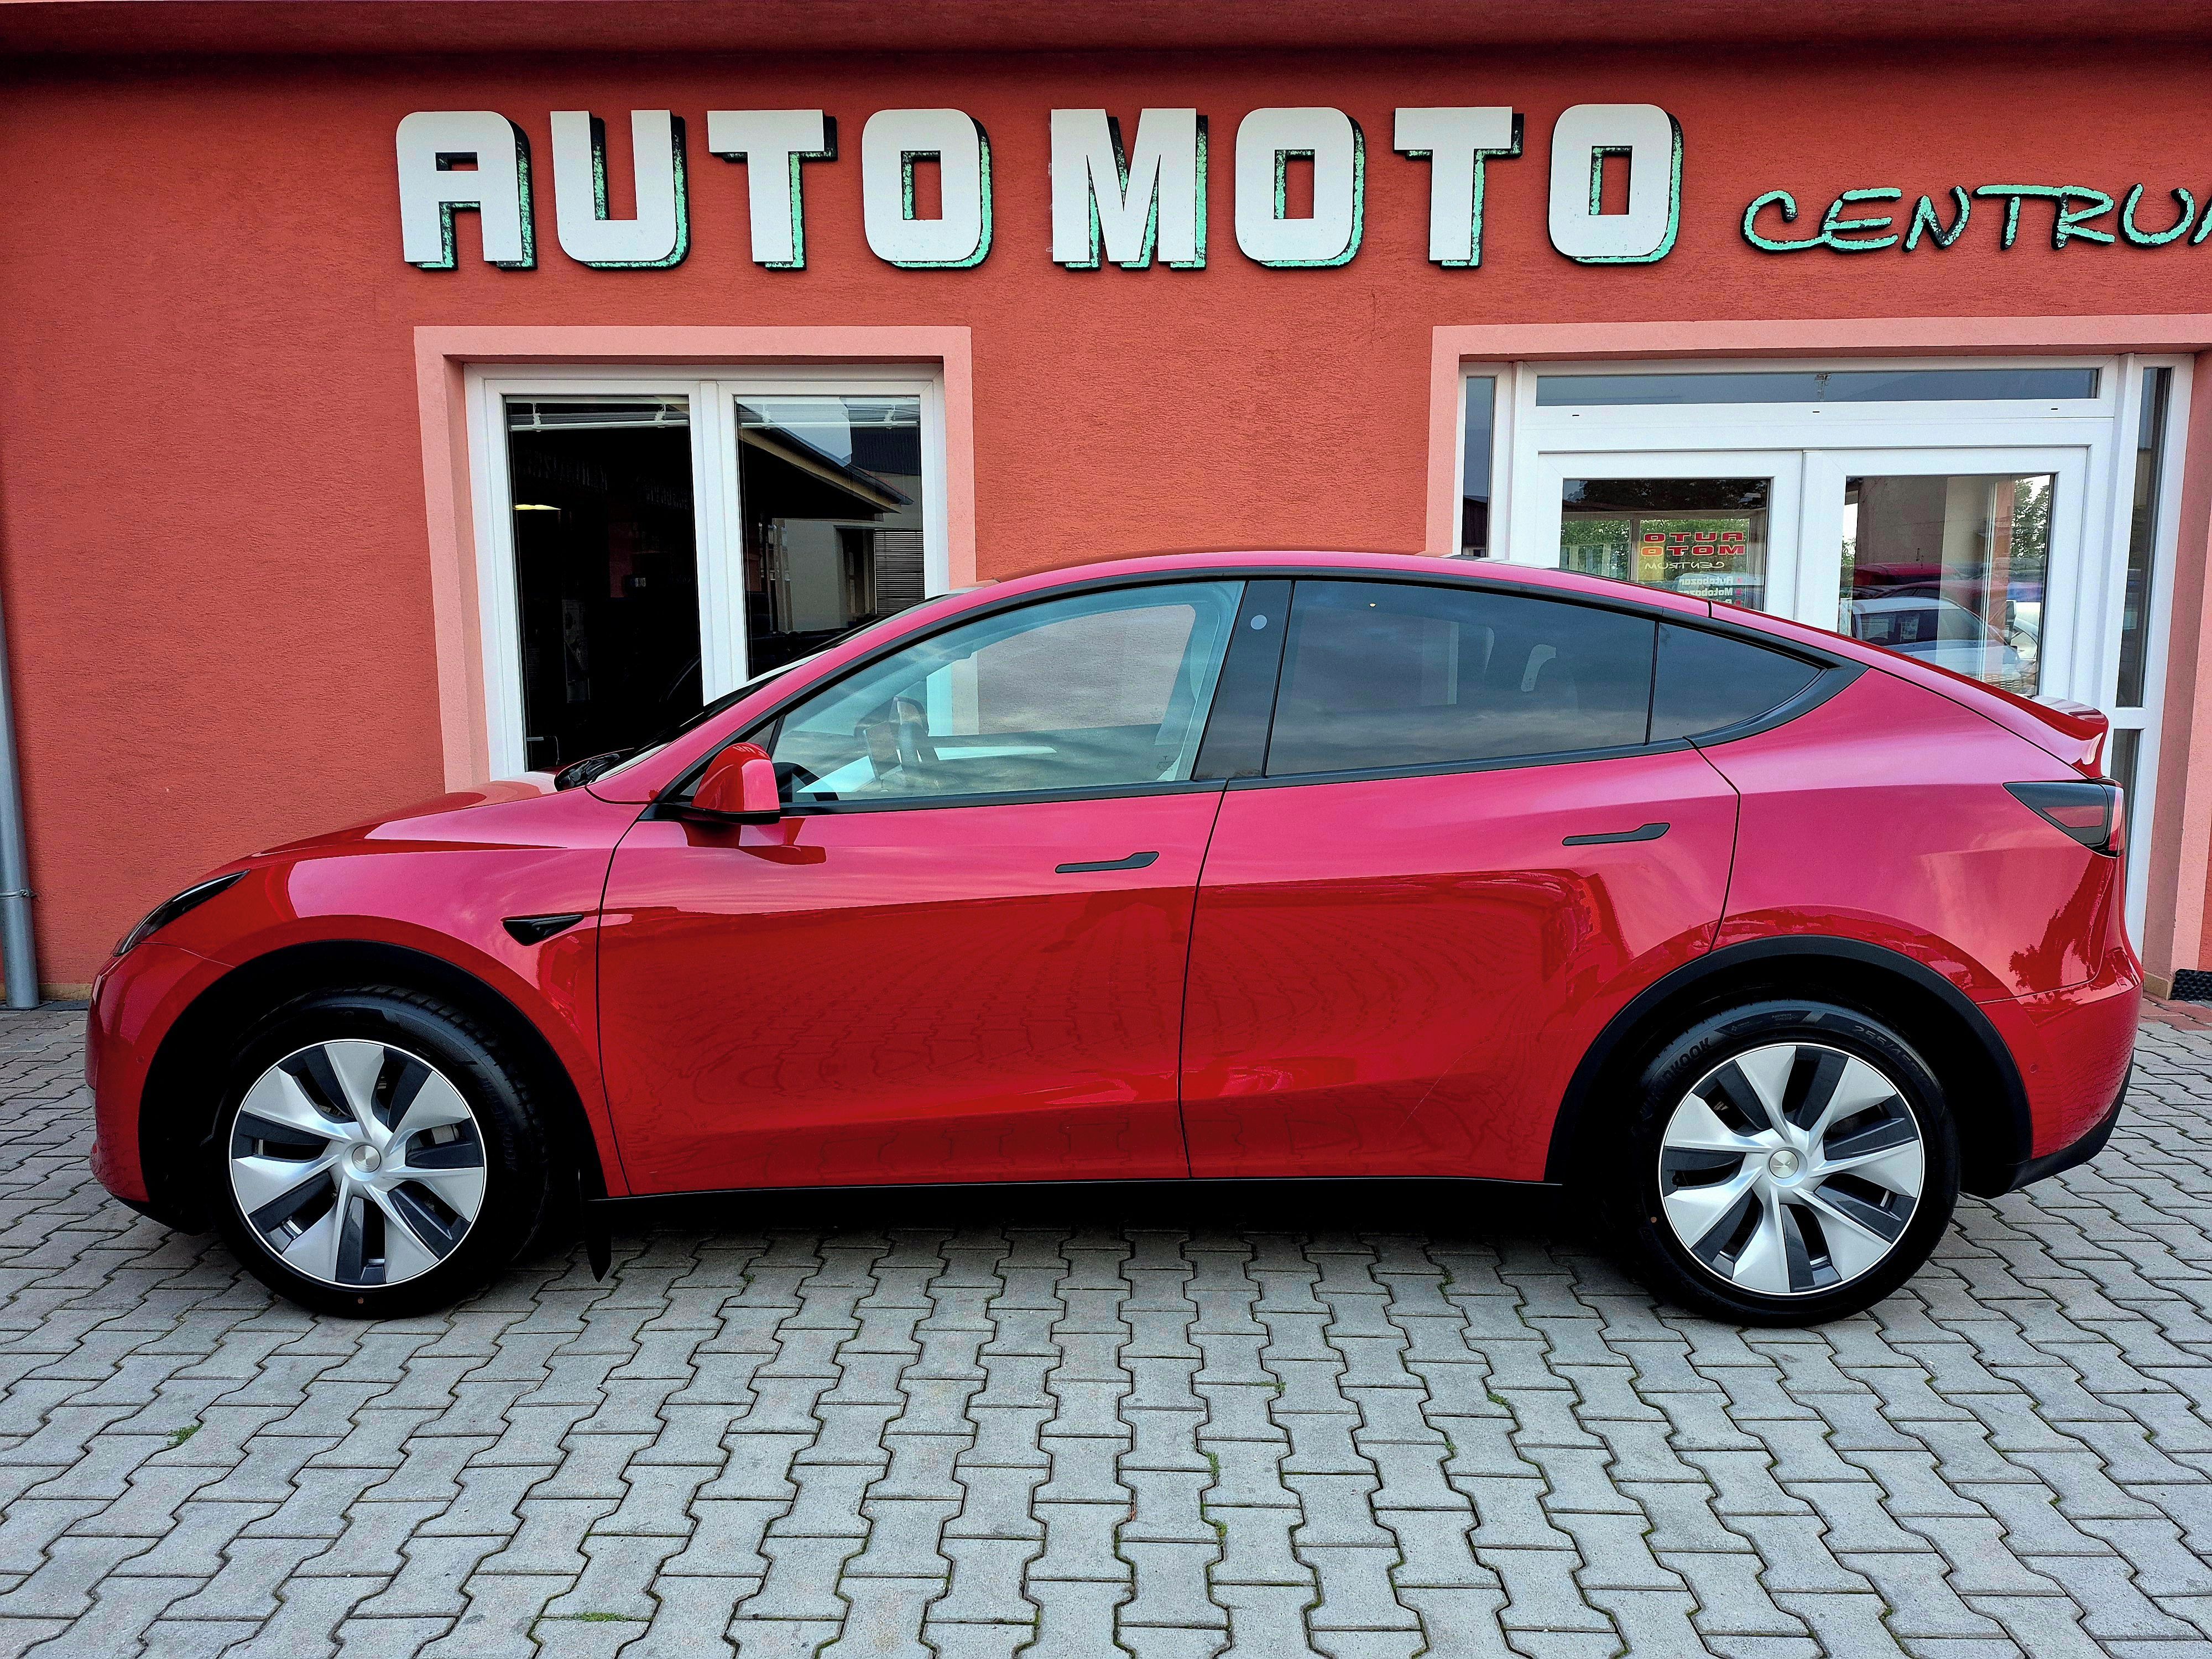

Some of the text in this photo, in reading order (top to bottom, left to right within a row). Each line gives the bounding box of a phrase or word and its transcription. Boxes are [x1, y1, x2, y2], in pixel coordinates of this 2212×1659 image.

[396, 103, 2212, 270] AUTO MOTO CENTRU
